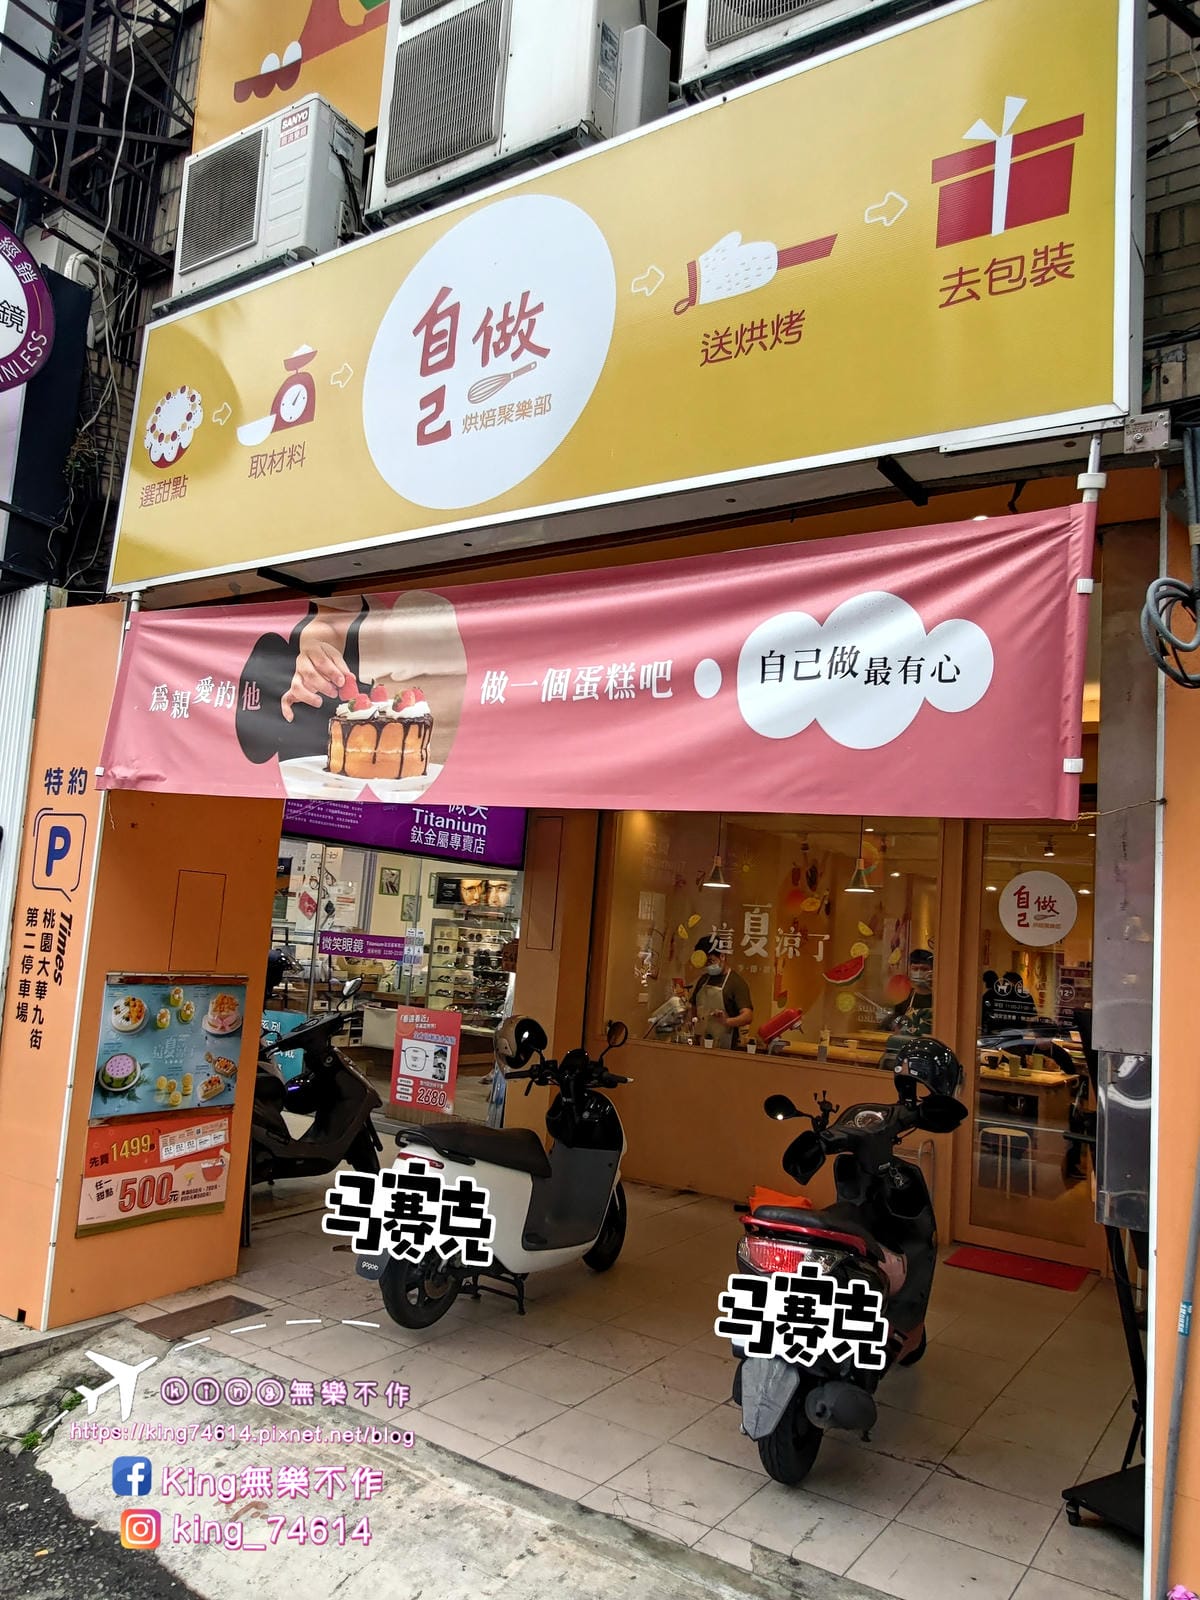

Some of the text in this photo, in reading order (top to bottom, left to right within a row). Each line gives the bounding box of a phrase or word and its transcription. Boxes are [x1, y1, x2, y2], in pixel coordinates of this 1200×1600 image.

[281, 110, 309, 130] SANYO
[937, 241, 1076, 310] 去包裝
[0, 330, 47, 383] NLESS
[699, 309, 806, 368] 送烘烤
[461, 394, 553, 435] 烘焙聚樂部
[248, 442, 307, 480] 取材料
[138, 475, 189, 511] 選甜點
[480, 659, 674, 705] 做一個蛋糕吧
[759, 645, 962, 687] 自己做最有心
[44, 766, 89, 797] 特約
[409, 825, 487, 855] 鈦金屬專賣店
[412, 808, 488, 836] Titanium
[45, 825, 71, 878] P
[15, 906, 40, 1024] 第二停車場
[53, 911, 74, 987] Times
[321, 935, 365, 954] 微笑眼鏡
[29, 907, 57, 1051] 桃園大華九街
[416, 1086, 447, 1108] 2680
